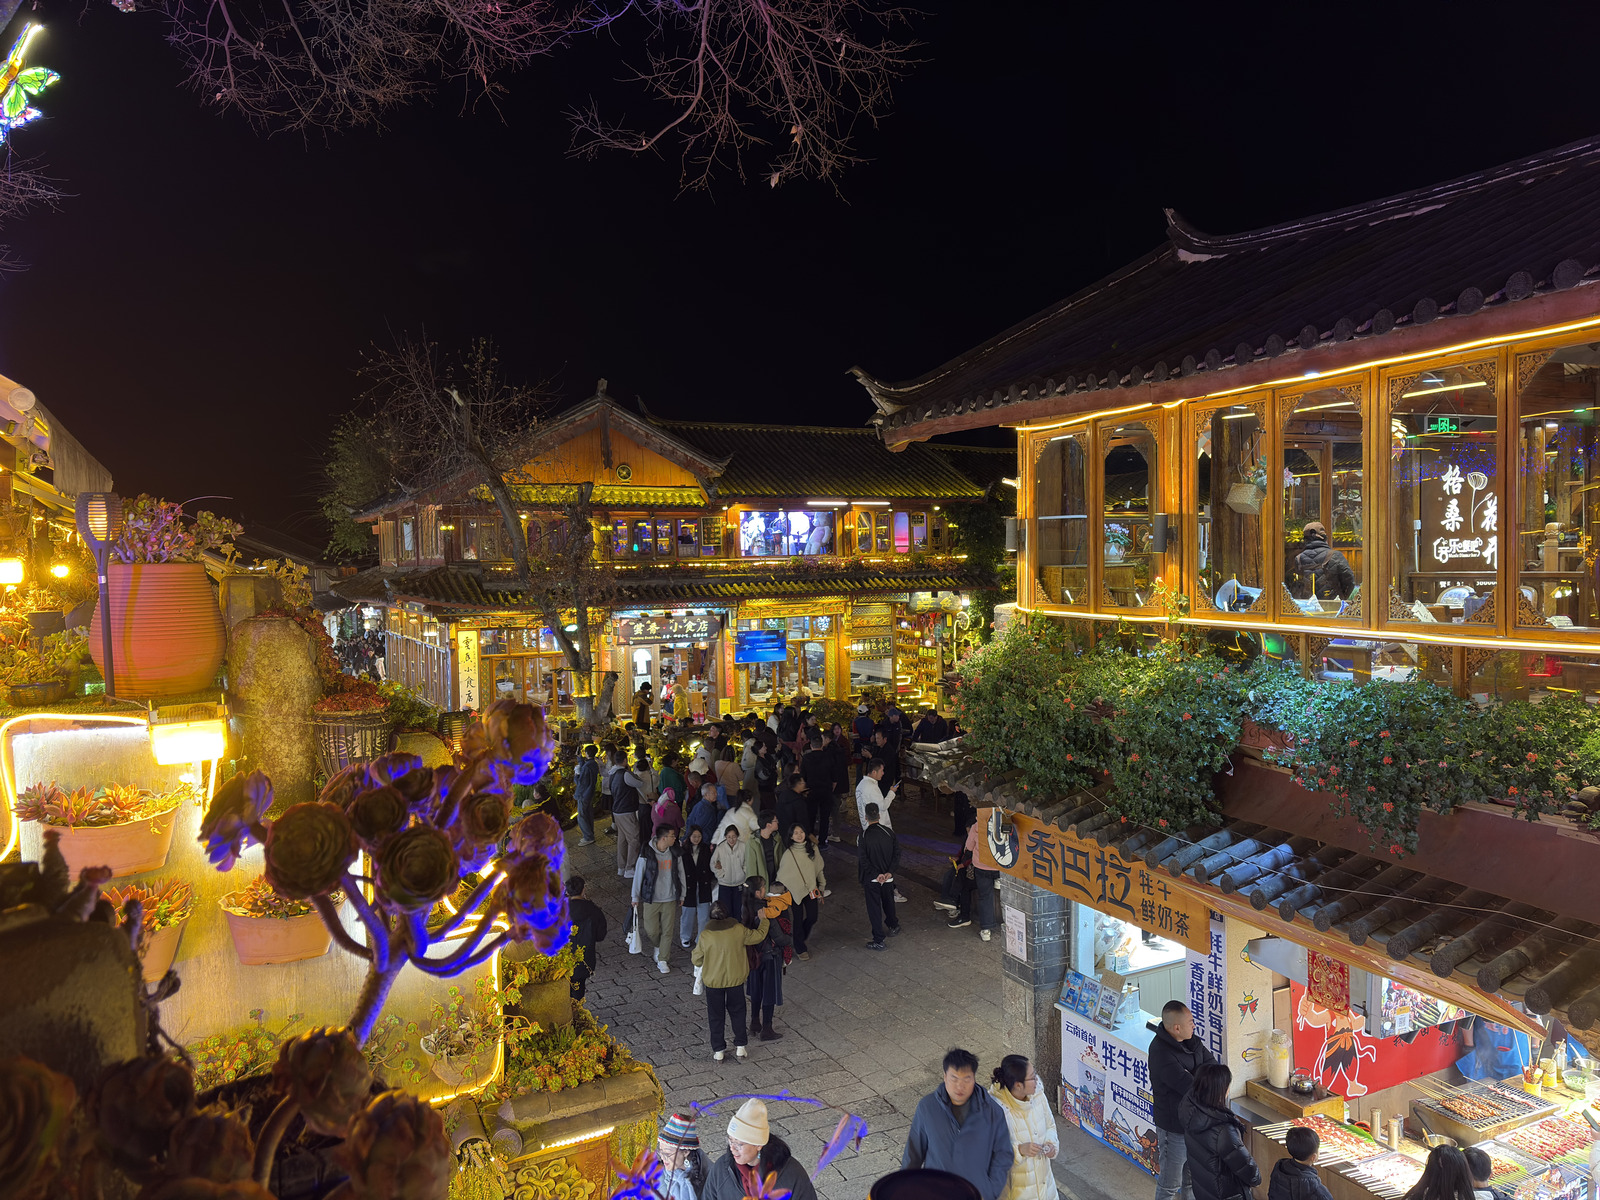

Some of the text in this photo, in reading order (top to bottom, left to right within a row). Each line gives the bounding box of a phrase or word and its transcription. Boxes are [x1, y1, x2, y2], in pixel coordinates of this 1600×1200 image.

[1440, 464, 1465, 533] 格桑
[1026, 829, 1136, 920] 香巴拉
[1140, 897, 1190, 940] 鲜奶茶
[1207, 931, 1223, 1064] 牦牛鲜奶每日
[1065, 1020, 1097, 1047] 云南首创
[1101, 1040, 1153, 1092] 牦牛鲜
